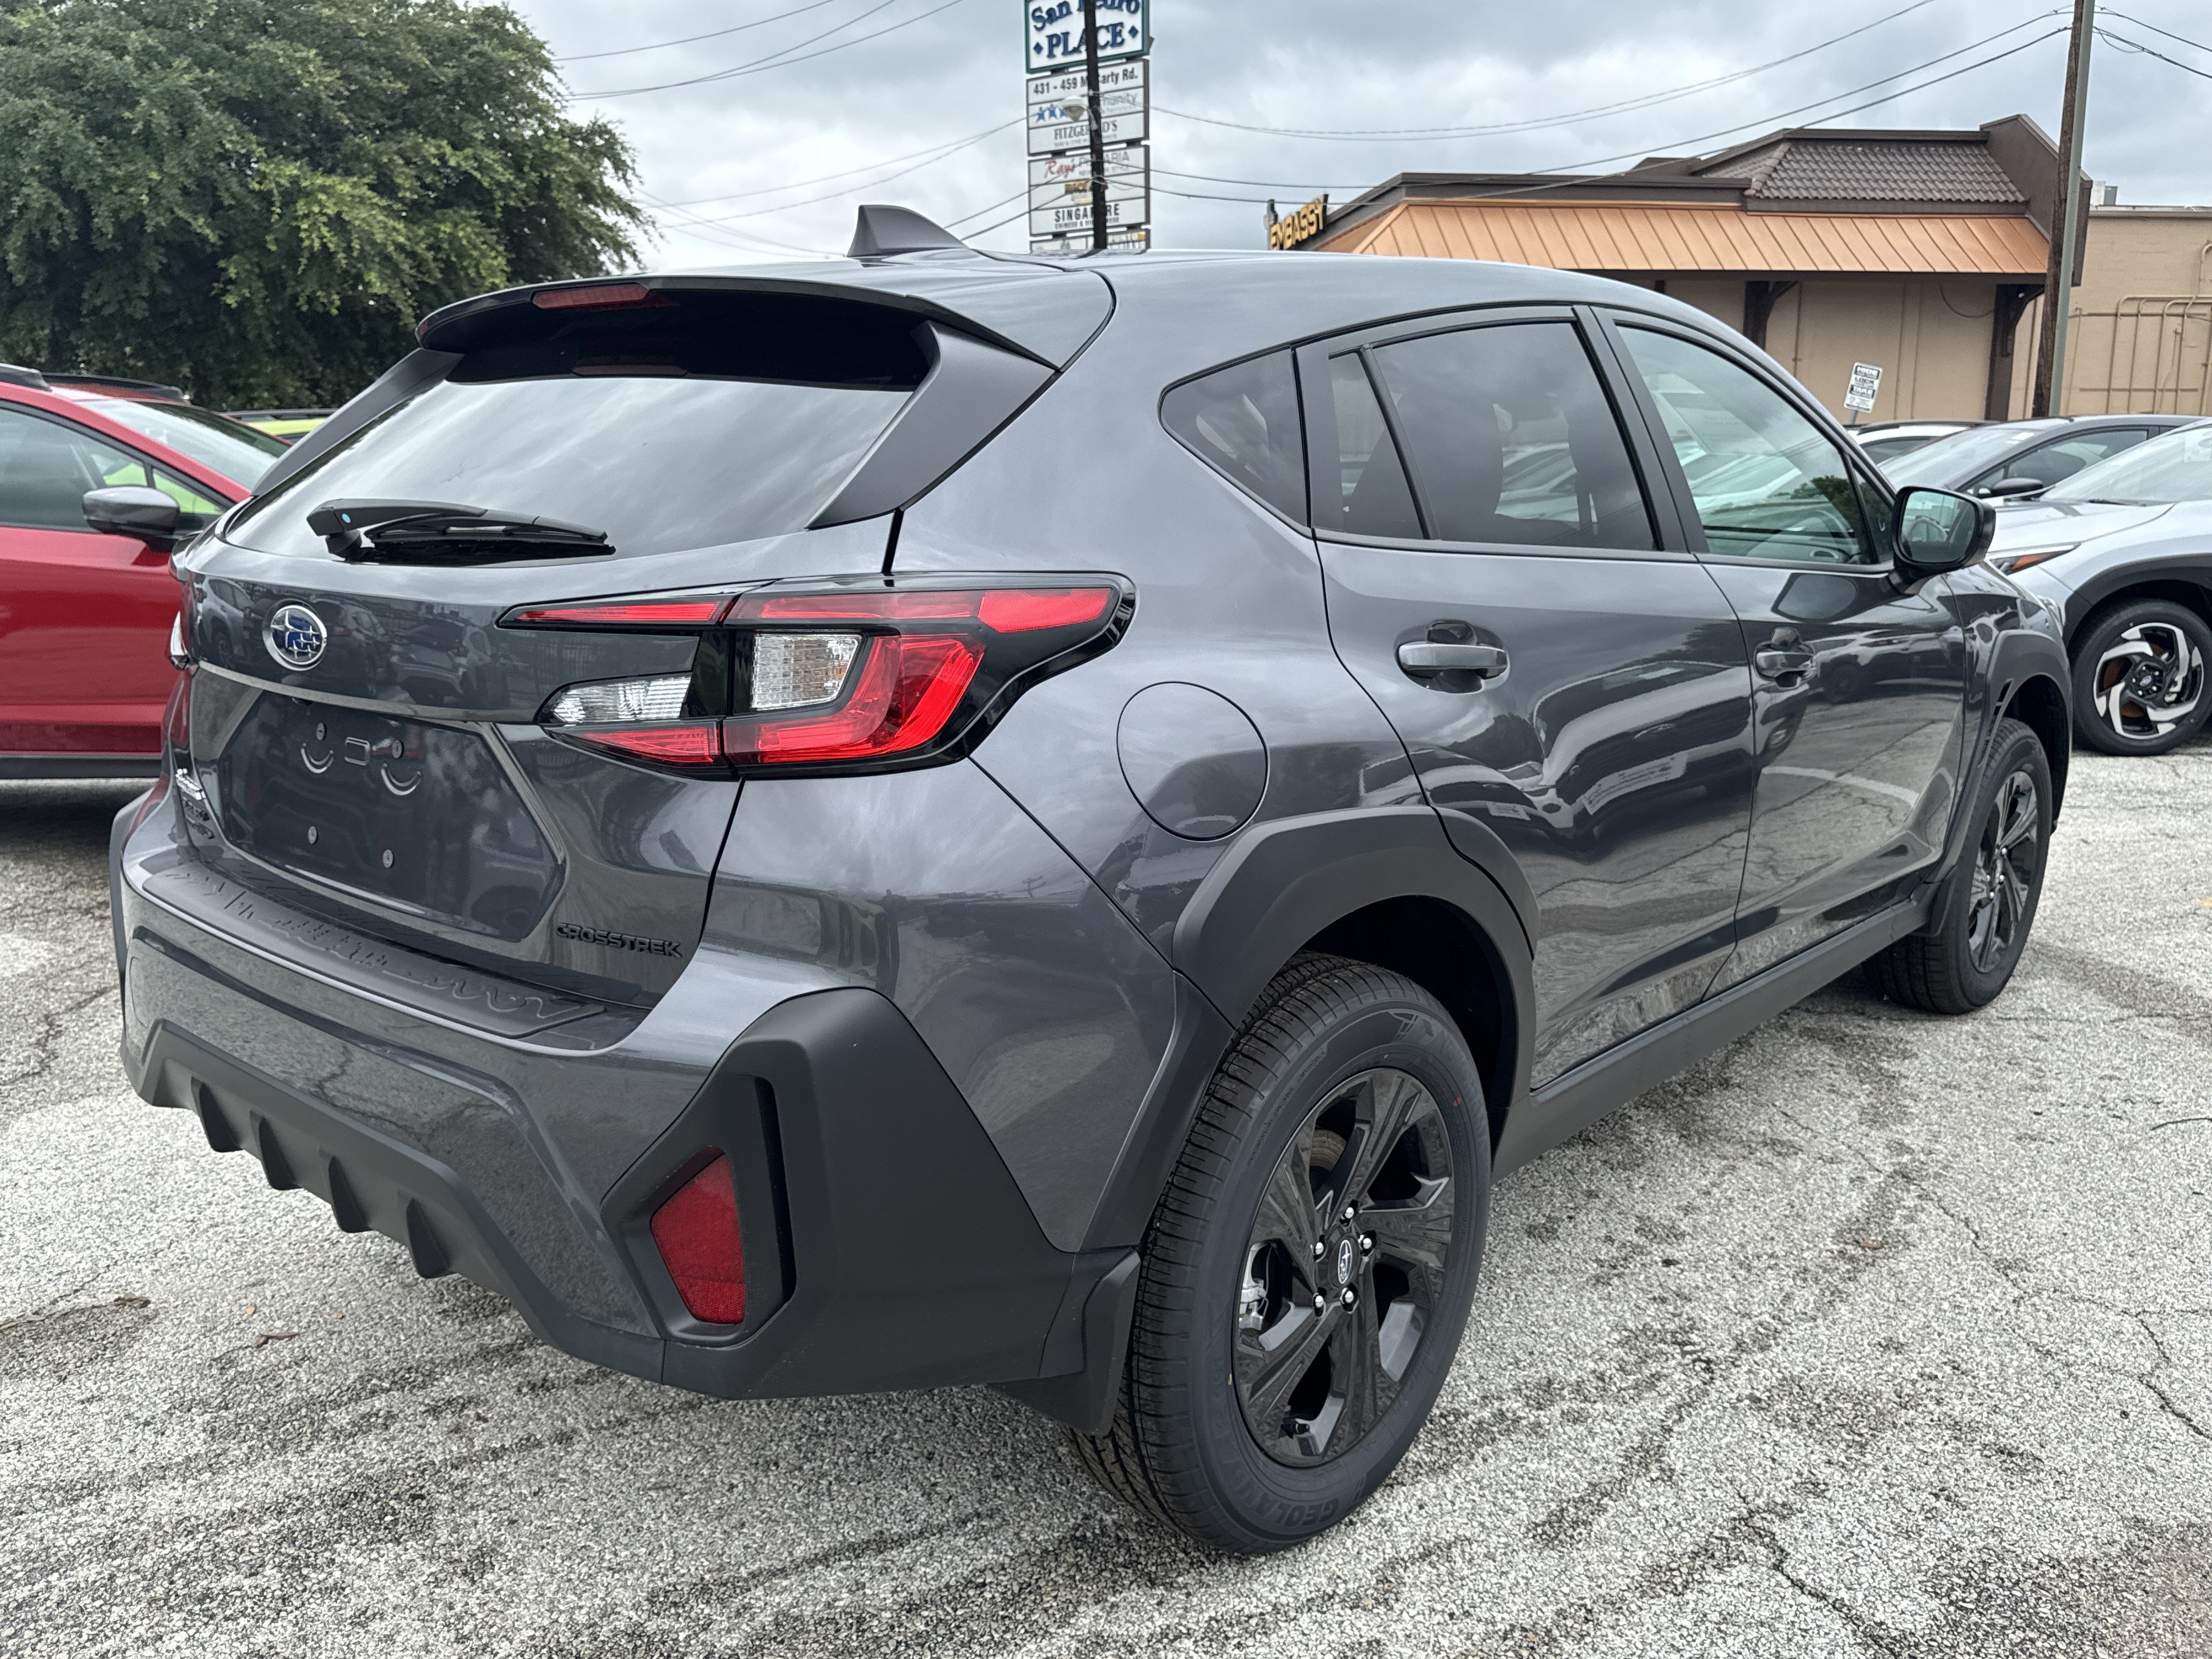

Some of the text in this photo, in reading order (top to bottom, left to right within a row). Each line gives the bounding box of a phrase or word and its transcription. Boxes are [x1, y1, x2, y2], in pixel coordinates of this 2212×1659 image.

[1031, 1, 1073, 32] San
[1033, 82, 1050, 95] 431
[1060, 77, 1077, 91] 459
[1122, 67, 1138, 81] Rd.
[1270, 195, 1328, 250] EMBASSY
[555, 922, 684, 958] CROSSTREK
